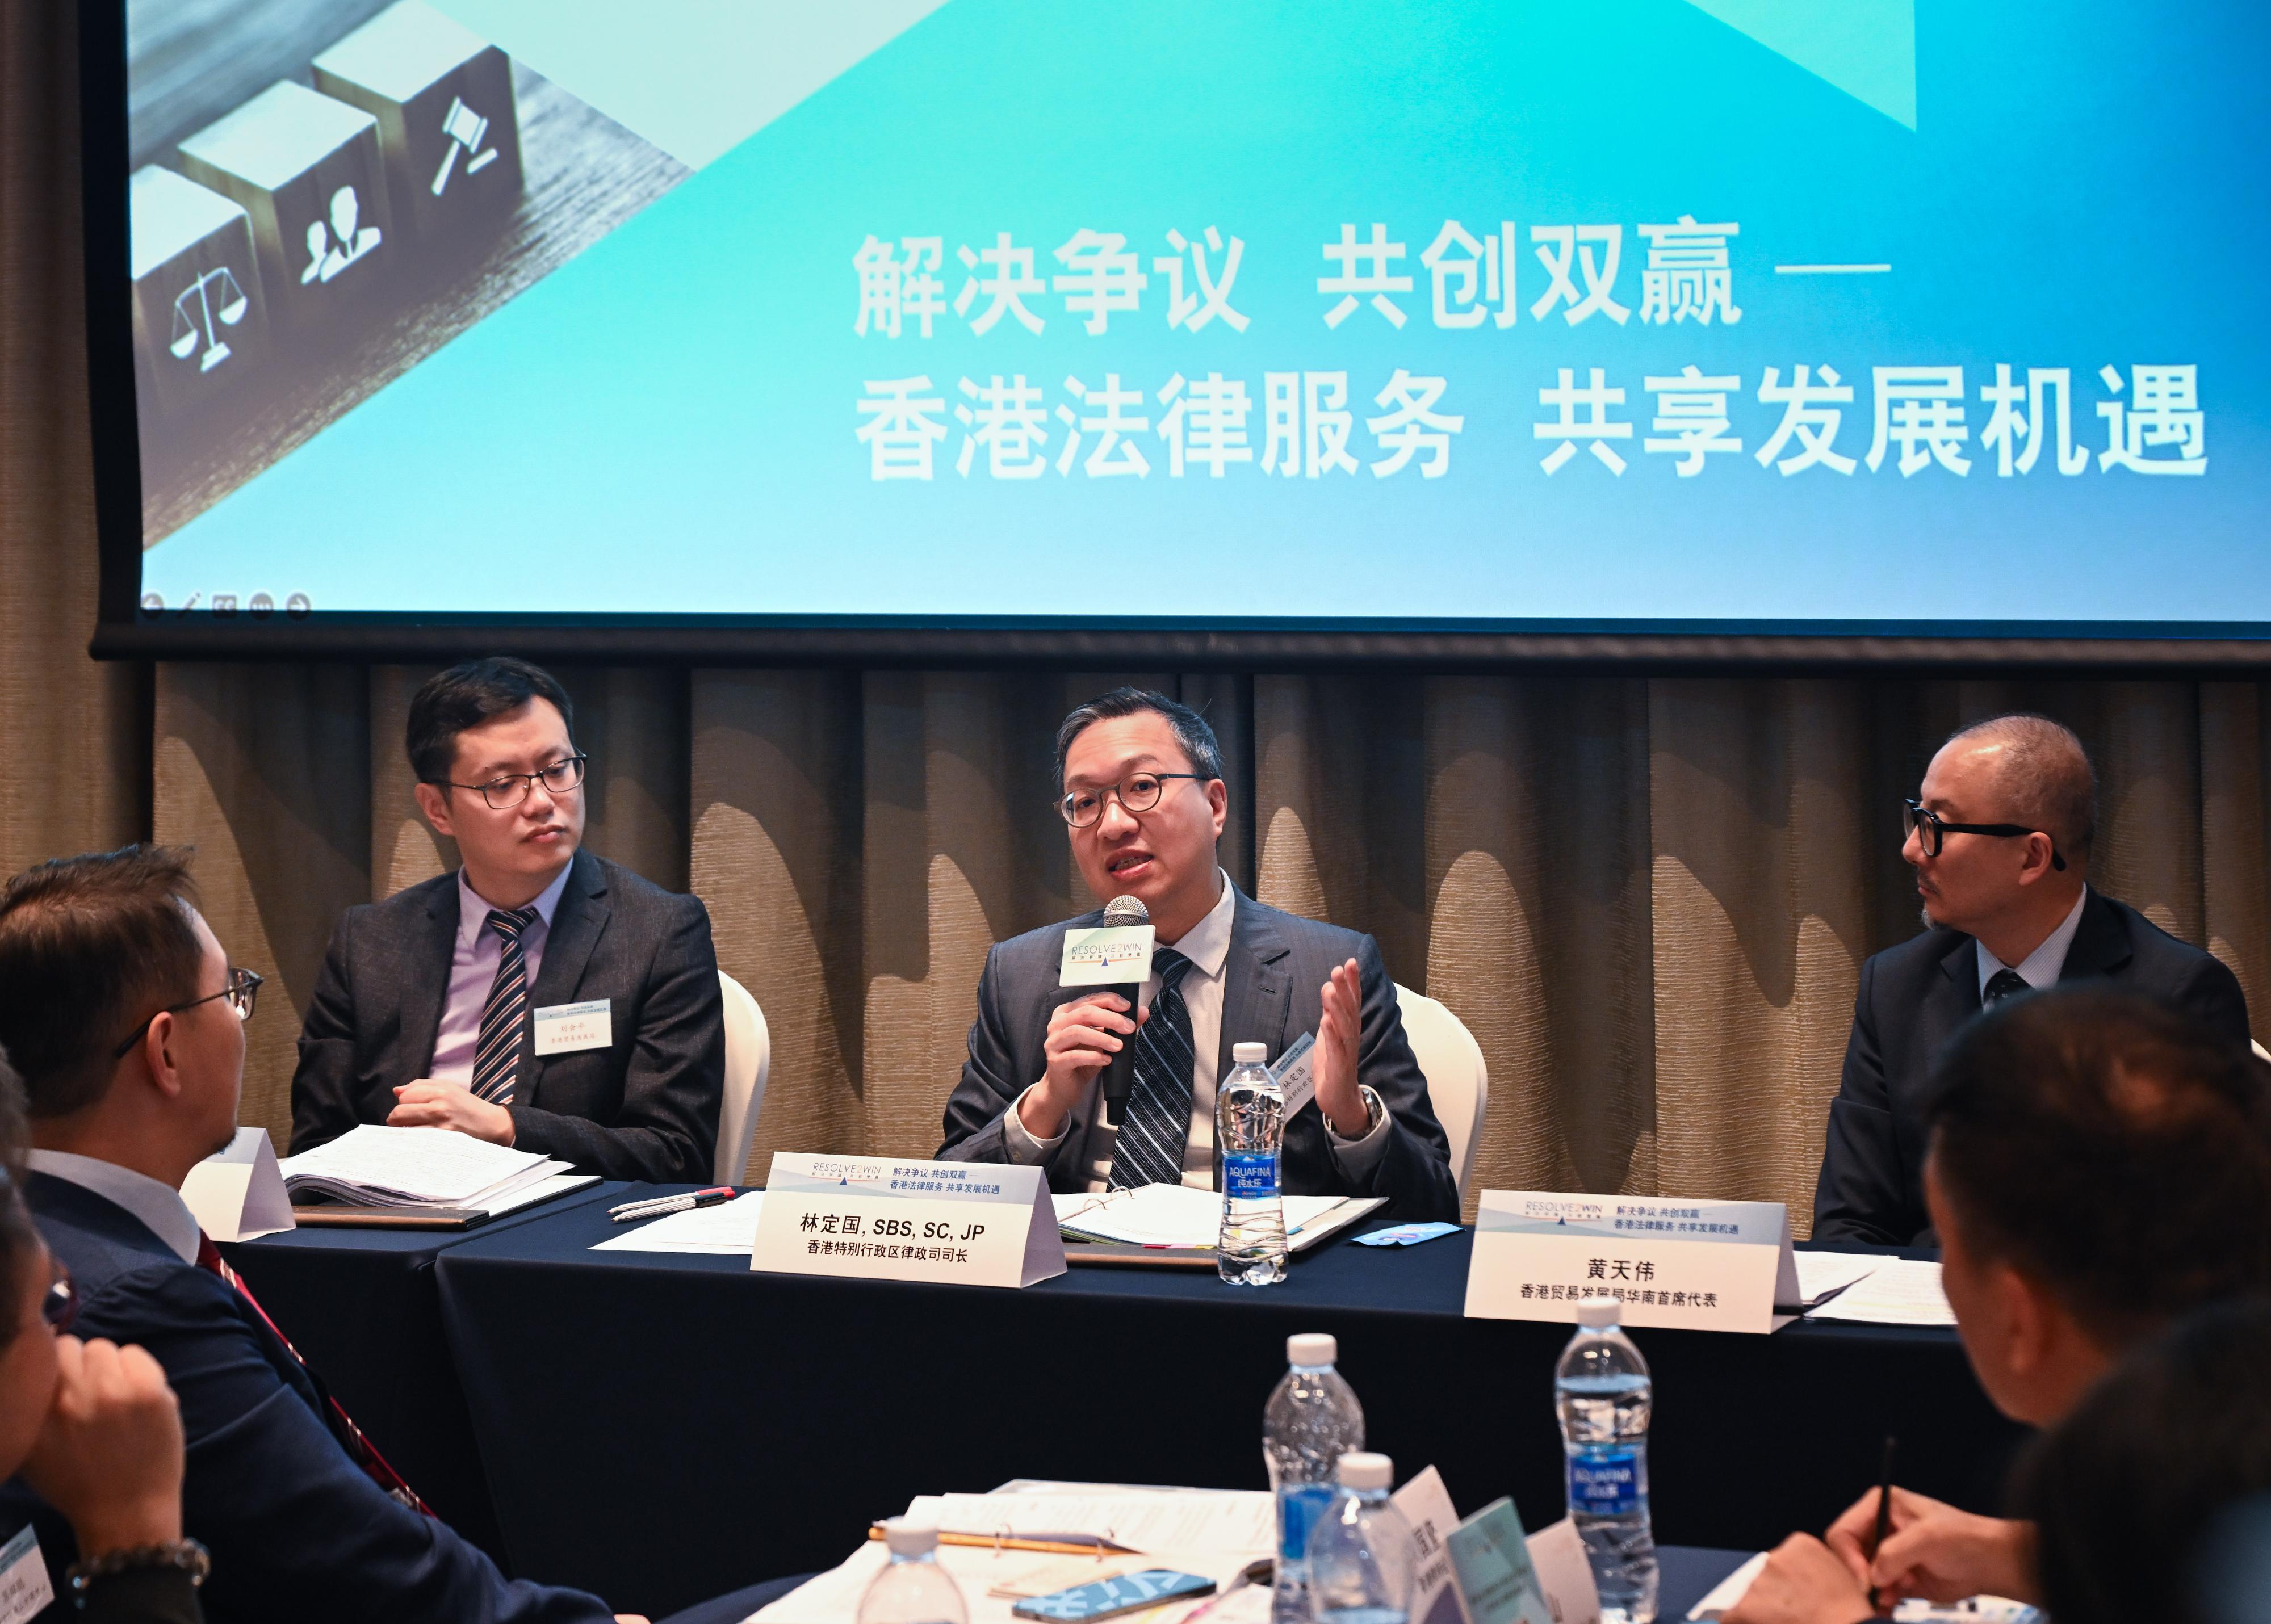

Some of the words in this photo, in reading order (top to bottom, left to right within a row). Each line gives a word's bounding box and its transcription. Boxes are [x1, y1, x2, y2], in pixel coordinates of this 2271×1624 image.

[852, 225, 1251, 338] 解决争议
[1317, 216, 1743, 330] 共创双赢
[854, 367, 1465, 481] 香港法律服务
[1533, 363, 2209, 478] 共享发展机遇
[1072, 943, 1141, 955] RESOLVE2WIN
[1283, 1066, 1305, 1089] 林定国
[813, 1163, 881, 1174] RESOLVE2WIN
[893, 1166, 929, 1178] 解决争议
[931, 1169, 967, 1180] 共创双赢
[1229, 1167, 1271, 1179] AQUAFINA
[890, 1180, 944, 1191] 香港法律服务
[945, 1182, 1000, 1195] 共享发展机遇
[1616, 1206, 1656, 1216] 解决争议
[799, 1213, 866, 1237] 林定国,
[873, 1219, 916, 1240] SBS,
[923, 1222, 953, 1242] SC,
[960, 1224, 985, 1241] JP
[1614, 1220, 1674, 1232] 香港法律服务
[807, 1240, 968, 1263] 香港特别行政区律政司司长
[1587, 1258, 1655, 1282] 黄天伟
[1520, 1283, 1718, 1308] 香港贸易发展局华南首席代表
